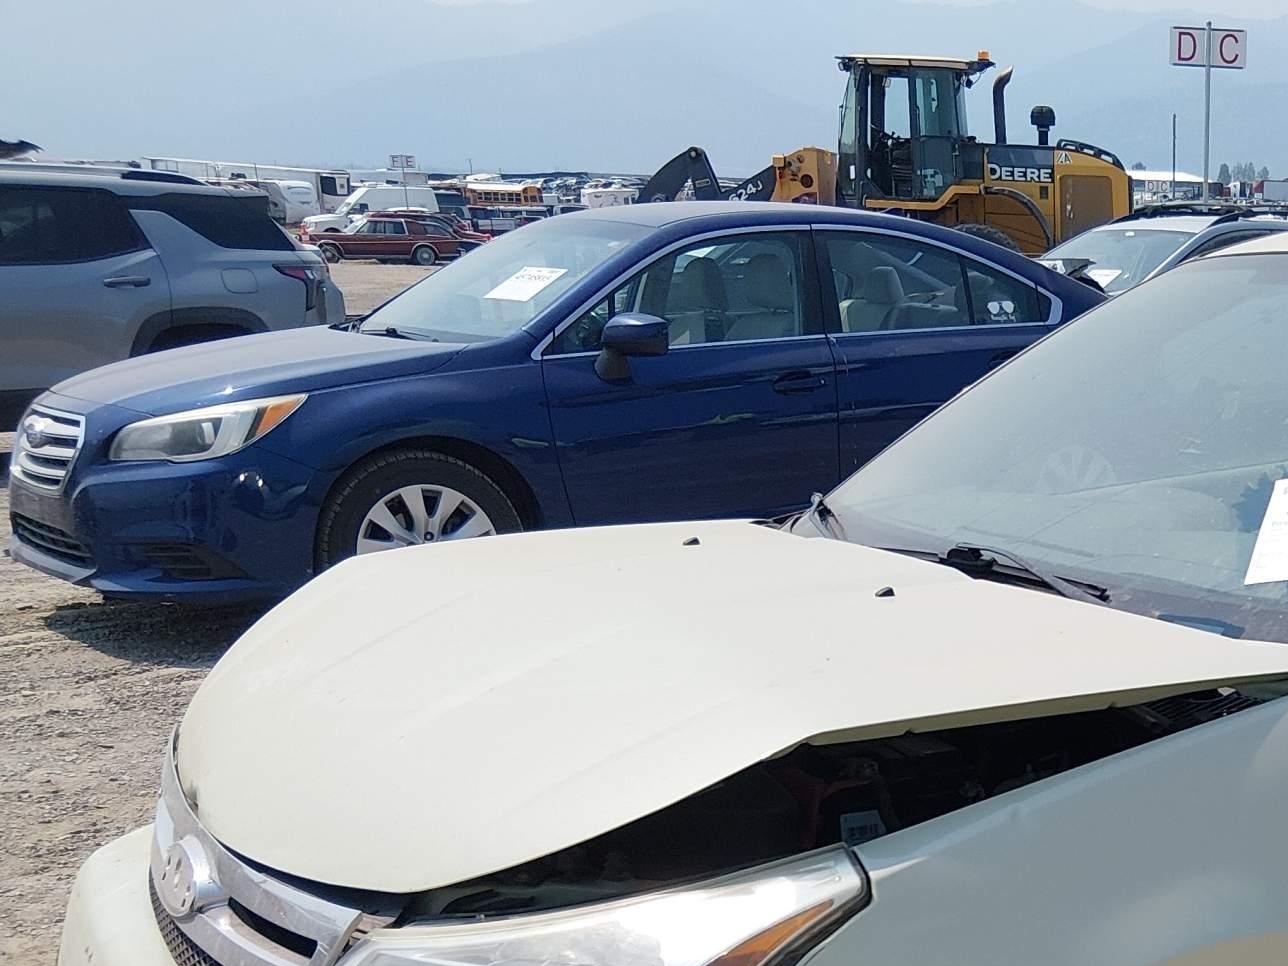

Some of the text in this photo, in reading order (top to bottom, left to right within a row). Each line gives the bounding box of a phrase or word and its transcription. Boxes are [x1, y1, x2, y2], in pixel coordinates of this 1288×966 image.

[1177, 31, 1240, 65] D C
[391, 155, 414, 167] F E
[987, 163, 1052, 183] DEERE
[1147, 181, 1169, 192] D C
